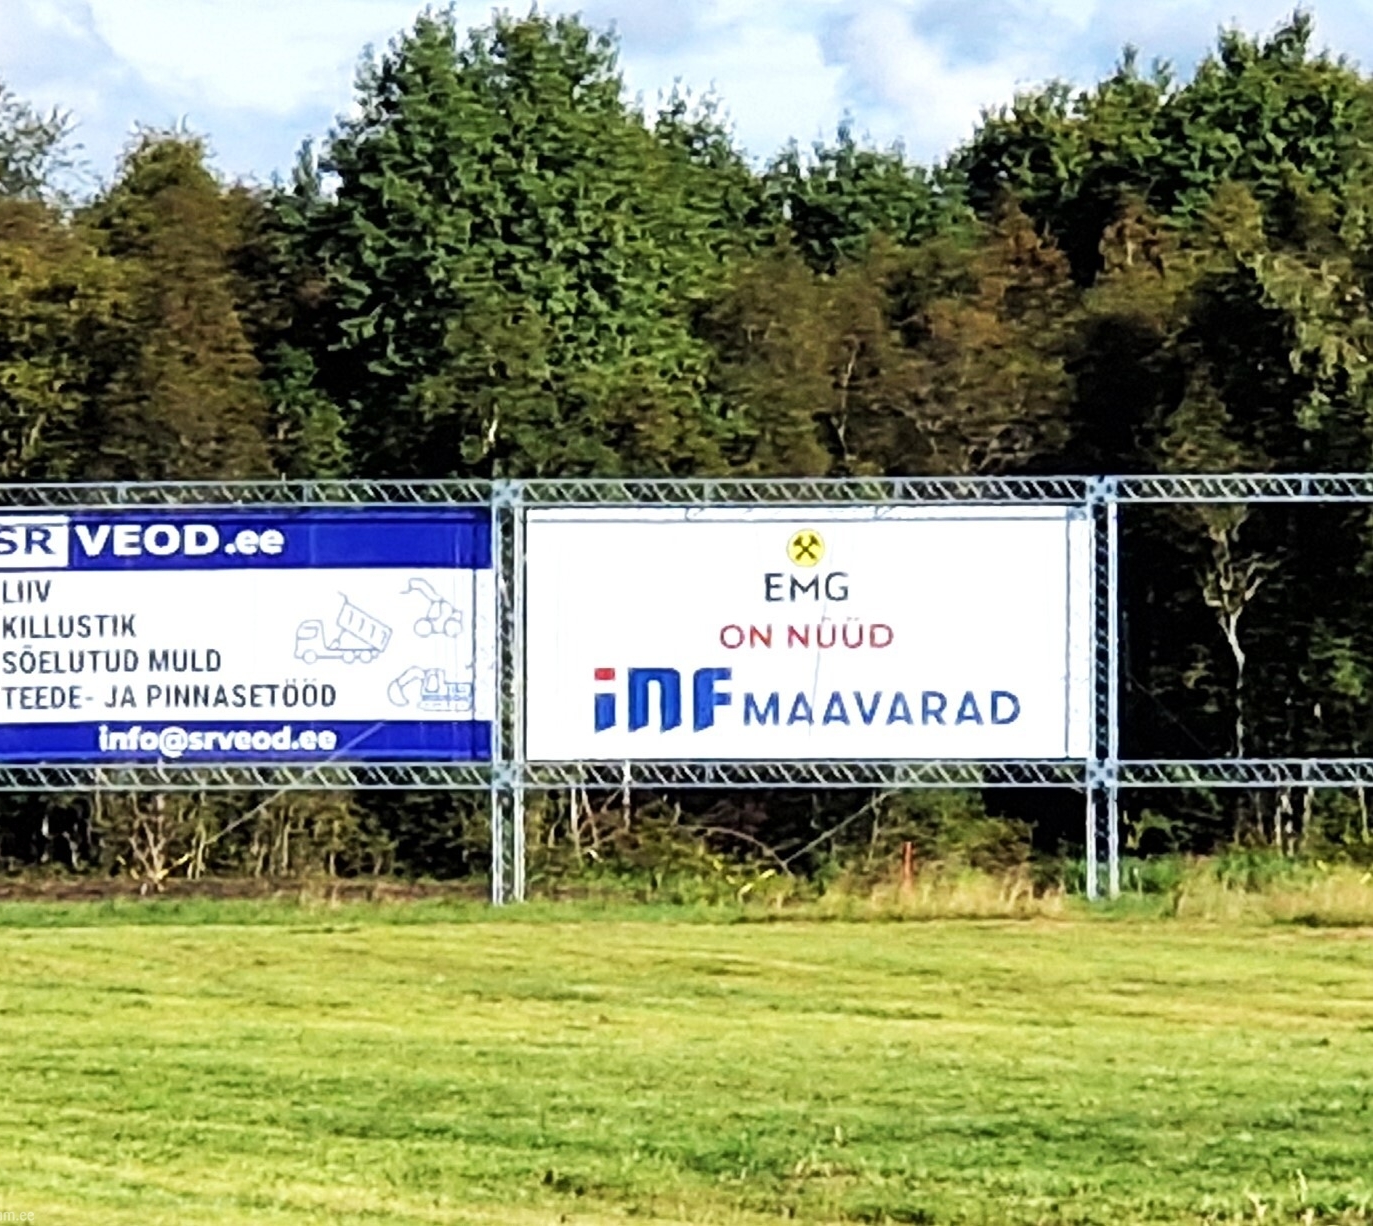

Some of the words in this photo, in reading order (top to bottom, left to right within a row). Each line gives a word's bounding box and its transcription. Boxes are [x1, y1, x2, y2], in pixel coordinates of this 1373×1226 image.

[1, 581, 52, 603] LIIV
[764, 572, 849, 602] EMG
[1, 615, 137, 638] KILLUSTIK
[719, 623, 773, 649] ON
[787, 616, 894, 649] NÜÜD
[2, 645, 139, 674] SÕELUTUD
[148, 649, 221, 672] MULD
[2, 686, 94, 709] TEEDE-
[104, 685, 137, 708] JA
[146, 678, 337, 708] PINNASETÖÖD
[743, 691, 1021, 726] MAAVARAD
[99, 725, 337, 758] info@srveod.ee
